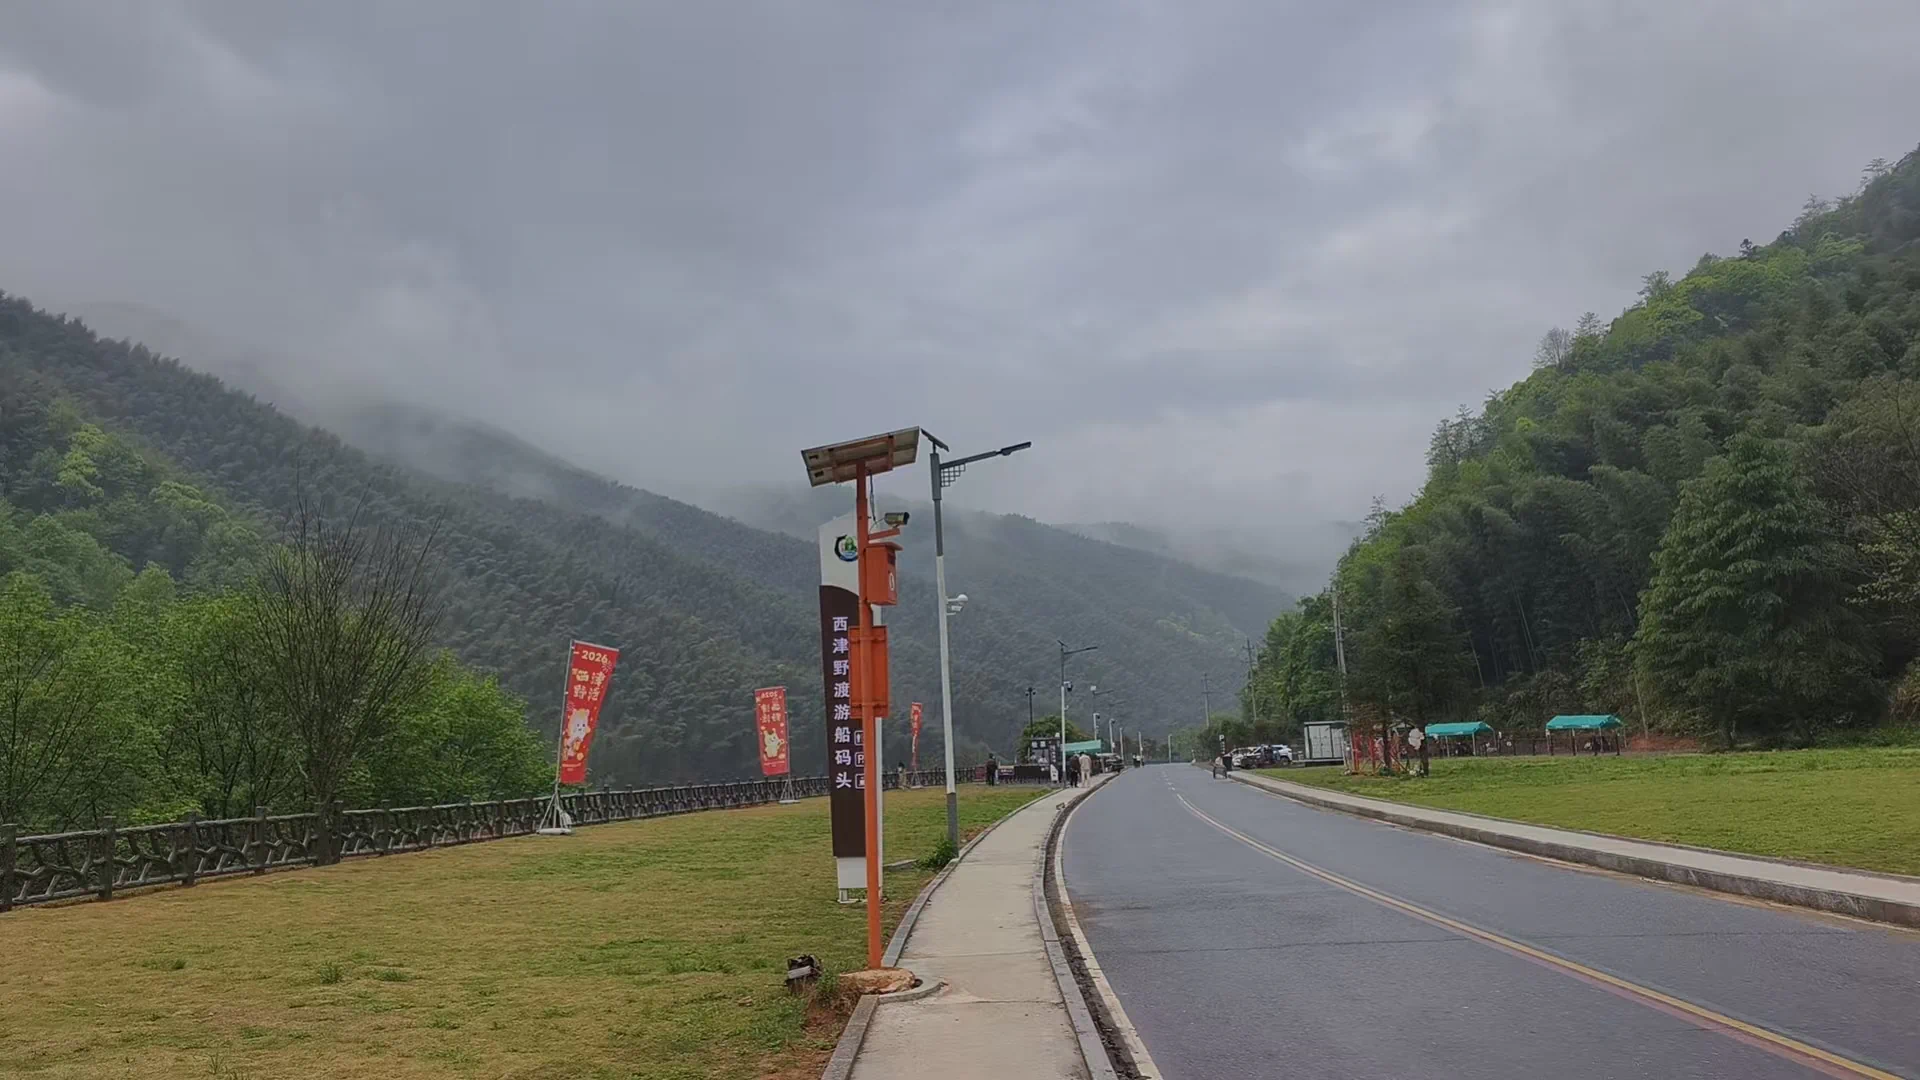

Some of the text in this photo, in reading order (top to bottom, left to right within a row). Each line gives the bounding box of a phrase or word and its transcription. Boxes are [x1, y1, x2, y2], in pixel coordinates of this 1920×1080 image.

[581, 650, 608, 664] 2026
[832, 616, 853, 789] 西津野渡游船码头
